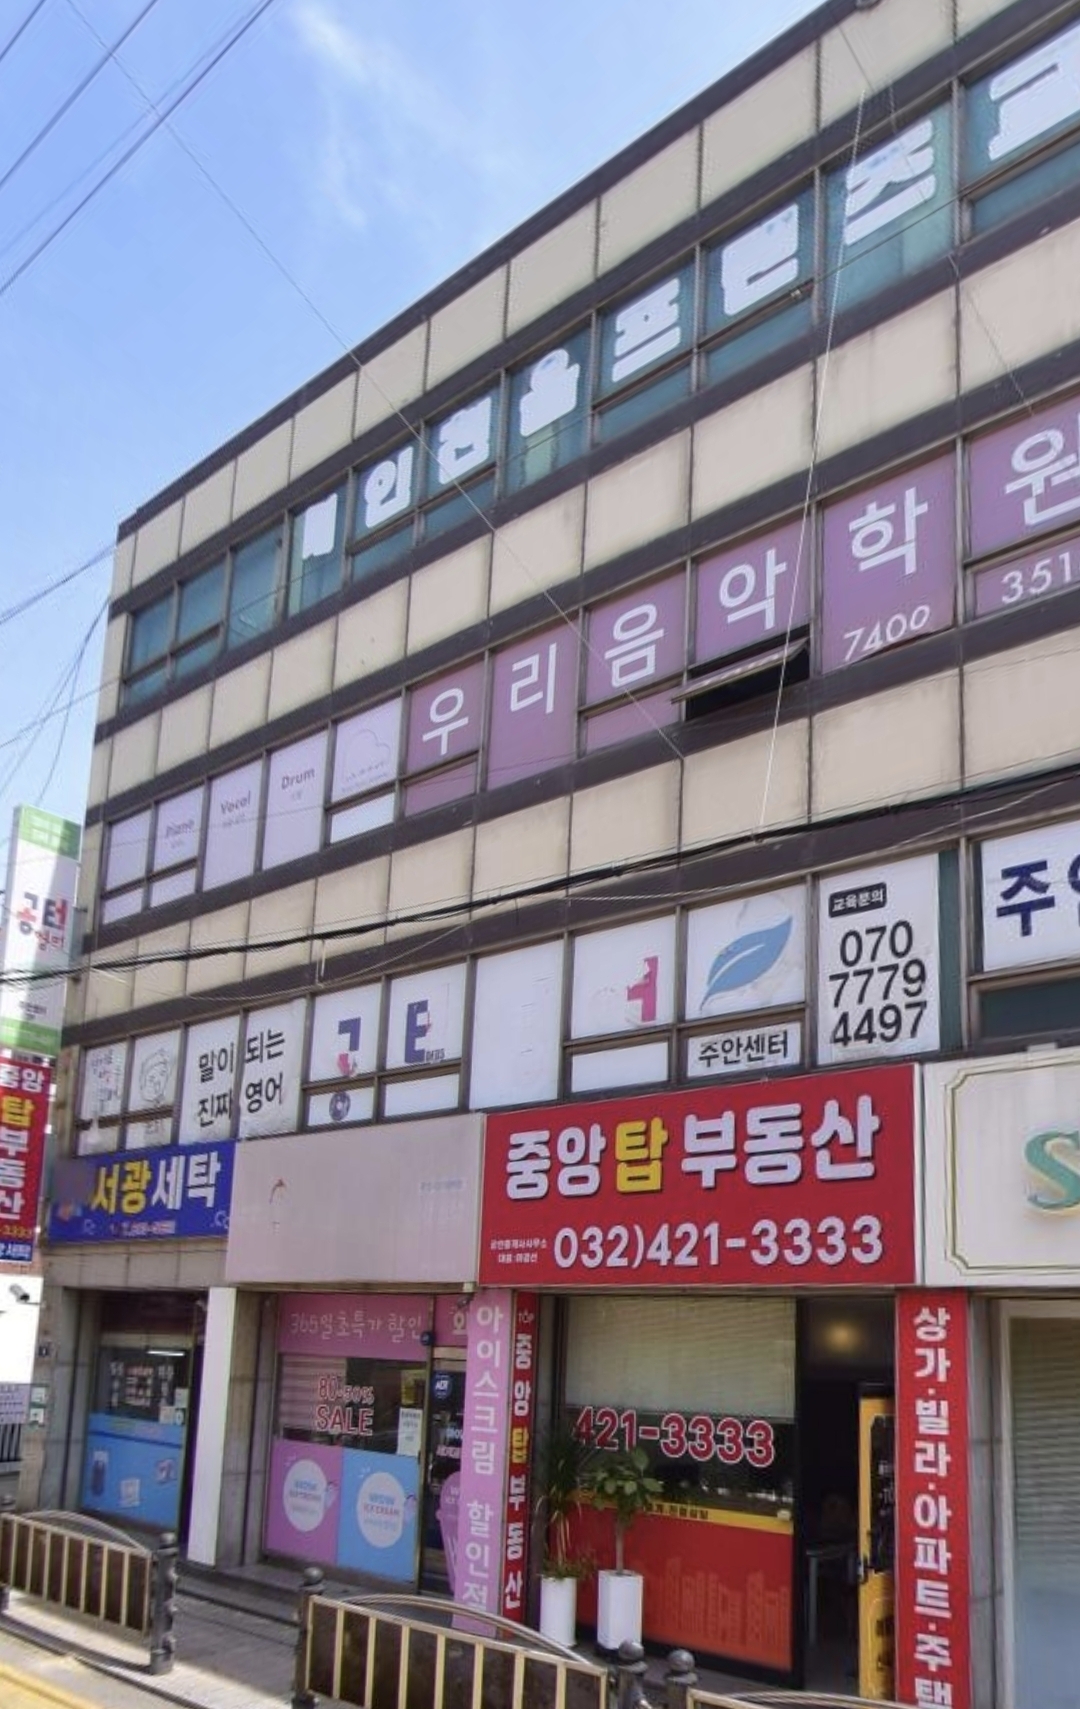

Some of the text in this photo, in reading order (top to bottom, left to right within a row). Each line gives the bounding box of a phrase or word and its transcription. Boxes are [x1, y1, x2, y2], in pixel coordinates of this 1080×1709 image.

[843, 604, 931, 663] 7400
[220, 789, 251, 815] Vocal
[280, 767, 316, 790] Drum
[831, 888, 885, 913] 교육문의
[839, 919, 914, 968] 070
[829, 958, 927, 1009] 7779
[697, 1029, 789, 1068] 주안센터
[831, 1000, 928, 1048] 4497
[199, 1029, 286, 1084] 말이 되는
[245, 1071, 284, 1115] 영어
[505, 1094, 880, 1201] 중앙 탑 부동산
[553, 1214, 883, 1269] 032)421-3333
[471, 1305, 504, 1475] 아이스크림
[315, 1403, 375, 1437] SALE
[572, 1405, 775, 1468] 421-3333
